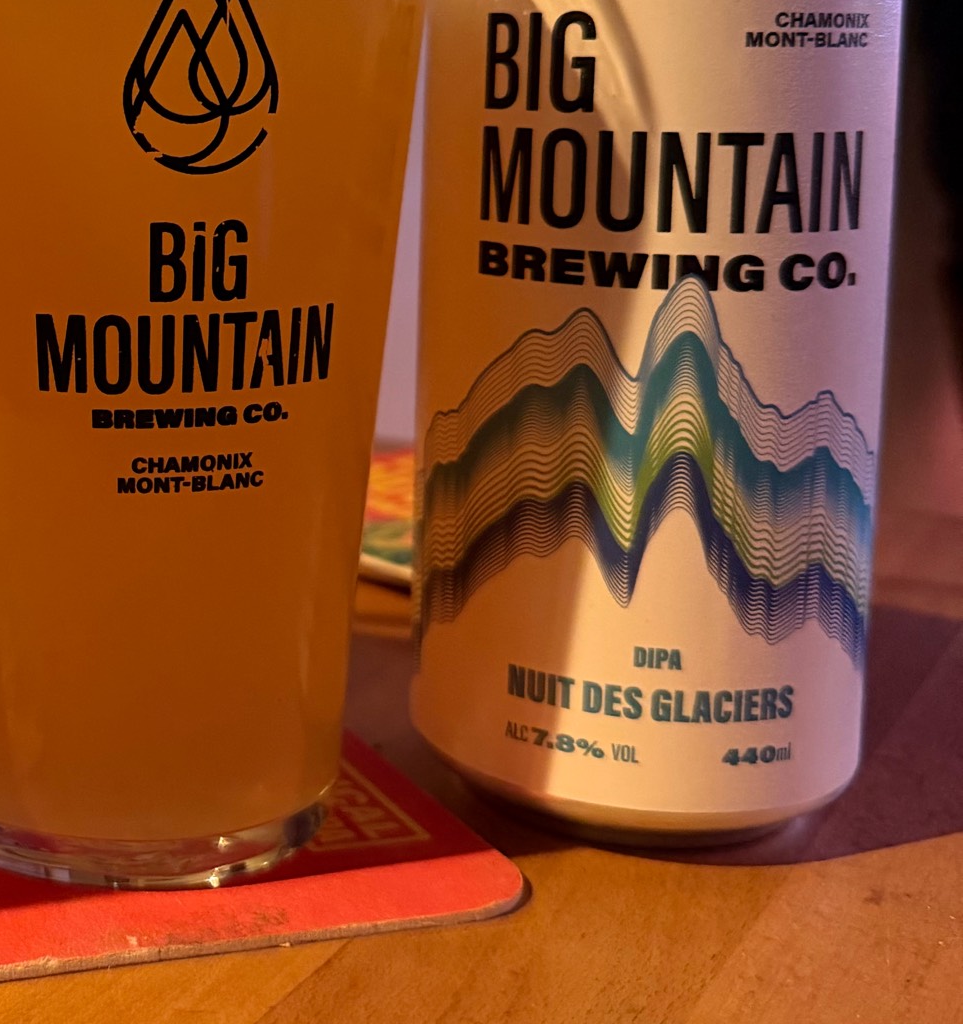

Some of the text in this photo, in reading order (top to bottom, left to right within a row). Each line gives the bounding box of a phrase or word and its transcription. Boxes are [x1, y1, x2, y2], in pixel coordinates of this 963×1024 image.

[775, 12, 869, 29] CHAMONIX
[745, 31, 868, 48] MONT-BLANC
[485, 10, 597, 113] BIG
[480, 125, 864, 234] MOUNTAIN
[478, 240, 856, 292] BREWING CO.
[36, 303, 334, 395] MOUNTAIN
[91, 401, 289, 430] BREWING CO.
[131, 452, 253, 474] CHAMONIX
[117, 471, 264, 494] MONT-BLANC
[633, 645, 683, 671] DIPA
[507, 663, 794, 724] NUIT DES GLACIERS
[505, 720, 640, 764] ALC 7.8% VOL
